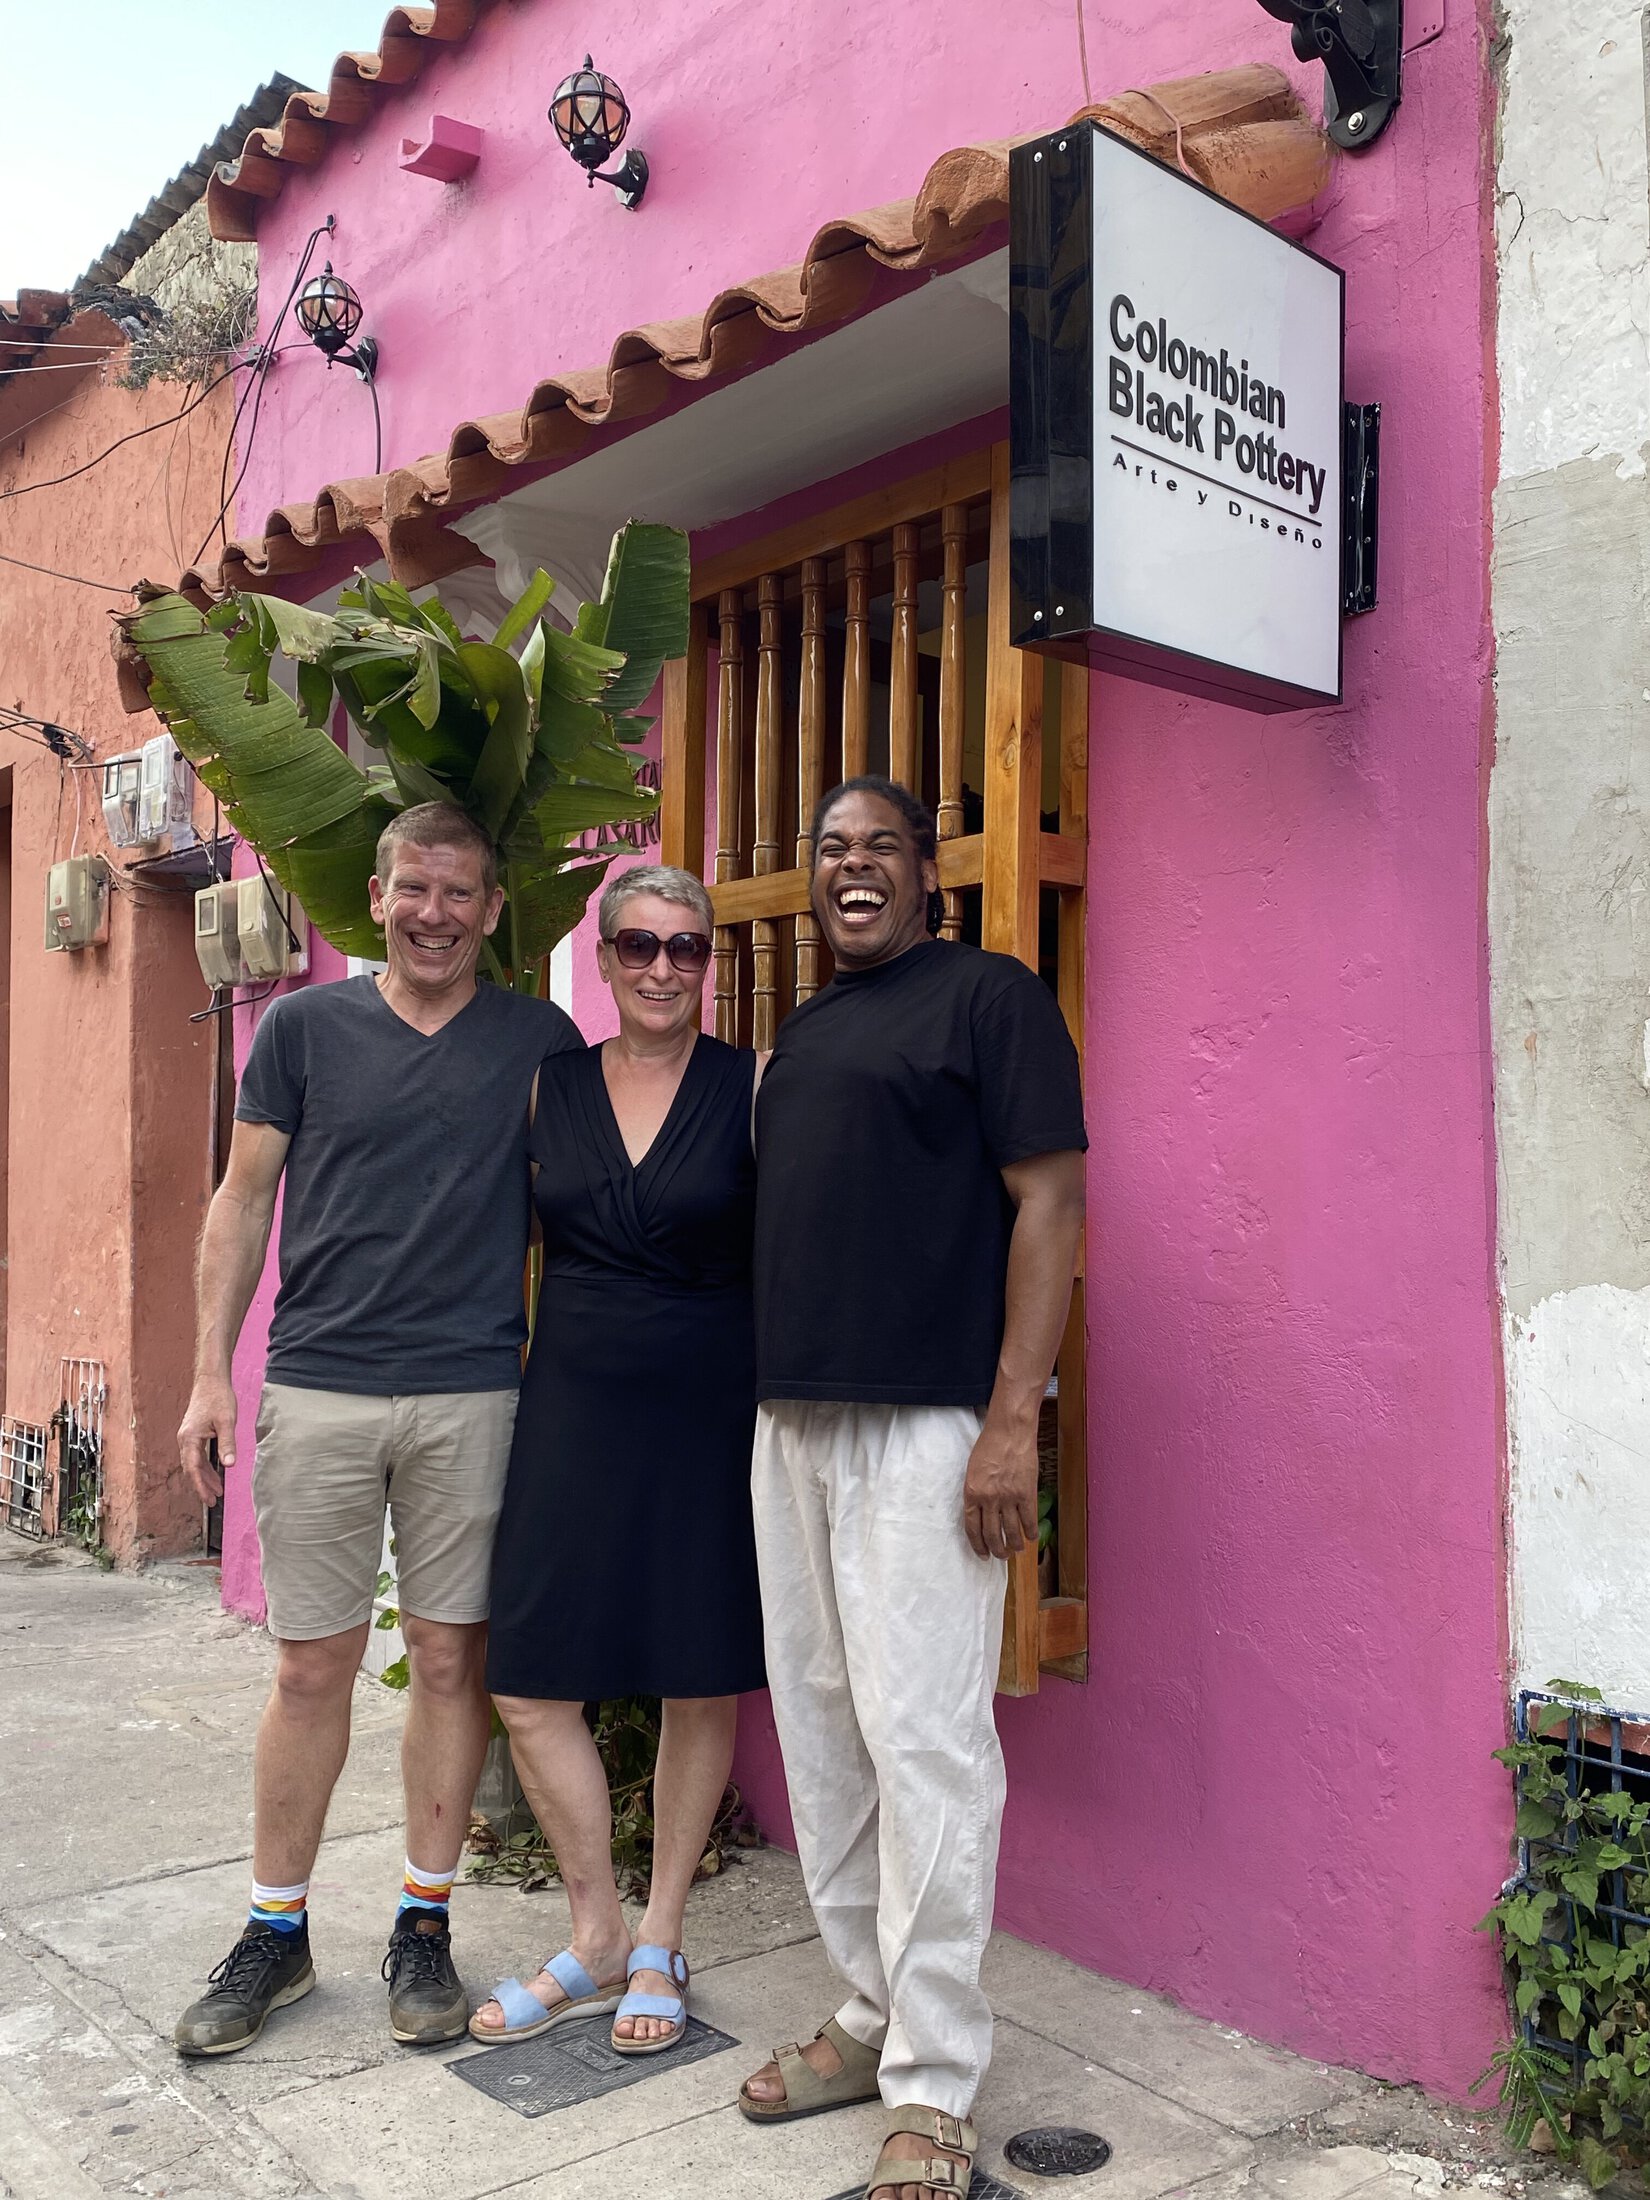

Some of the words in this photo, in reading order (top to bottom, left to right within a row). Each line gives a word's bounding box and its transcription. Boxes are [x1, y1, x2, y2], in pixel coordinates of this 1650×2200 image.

[1109, 293, 1286, 430] Colombian
[1109, 355, 1205, 453] Black
[1214, 407, 1327, 515] Pottery
[1112, 451, 1178, 492] Arte
[1197, 489, 1208, 506] y
